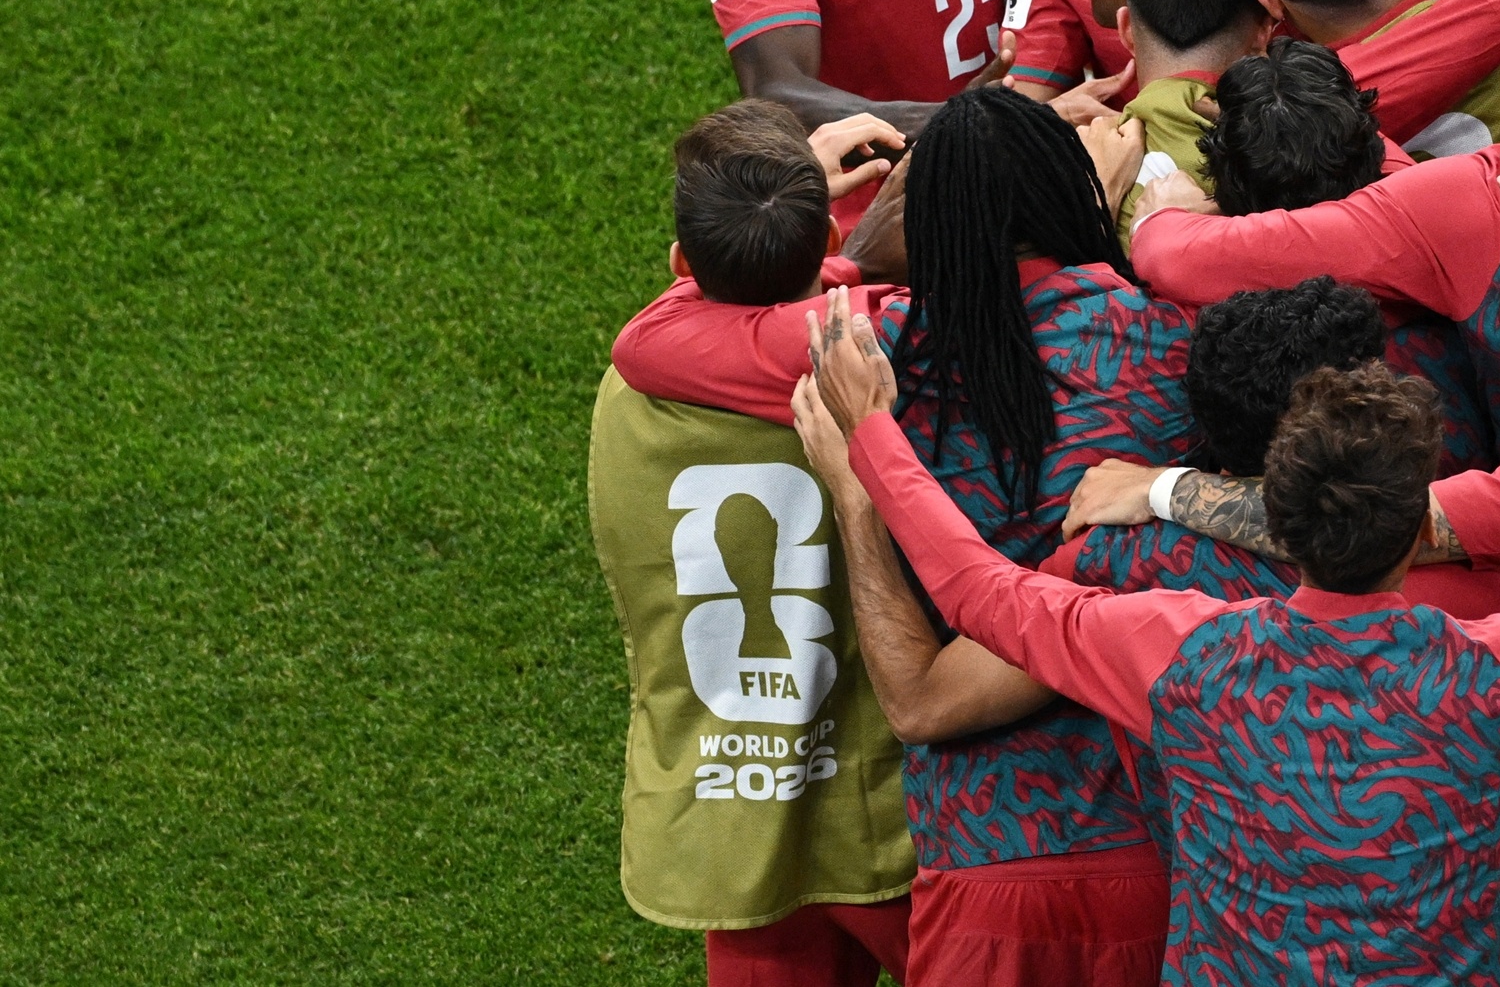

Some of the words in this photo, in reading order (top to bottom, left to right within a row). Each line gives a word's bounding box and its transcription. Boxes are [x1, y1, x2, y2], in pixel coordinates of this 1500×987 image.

[738, 670, 802, 701] FIFA
[699, 733, 790, 759] WORLD
[794, 718, 836, 757] CUP
[694, 745, 838, 801] 2026
